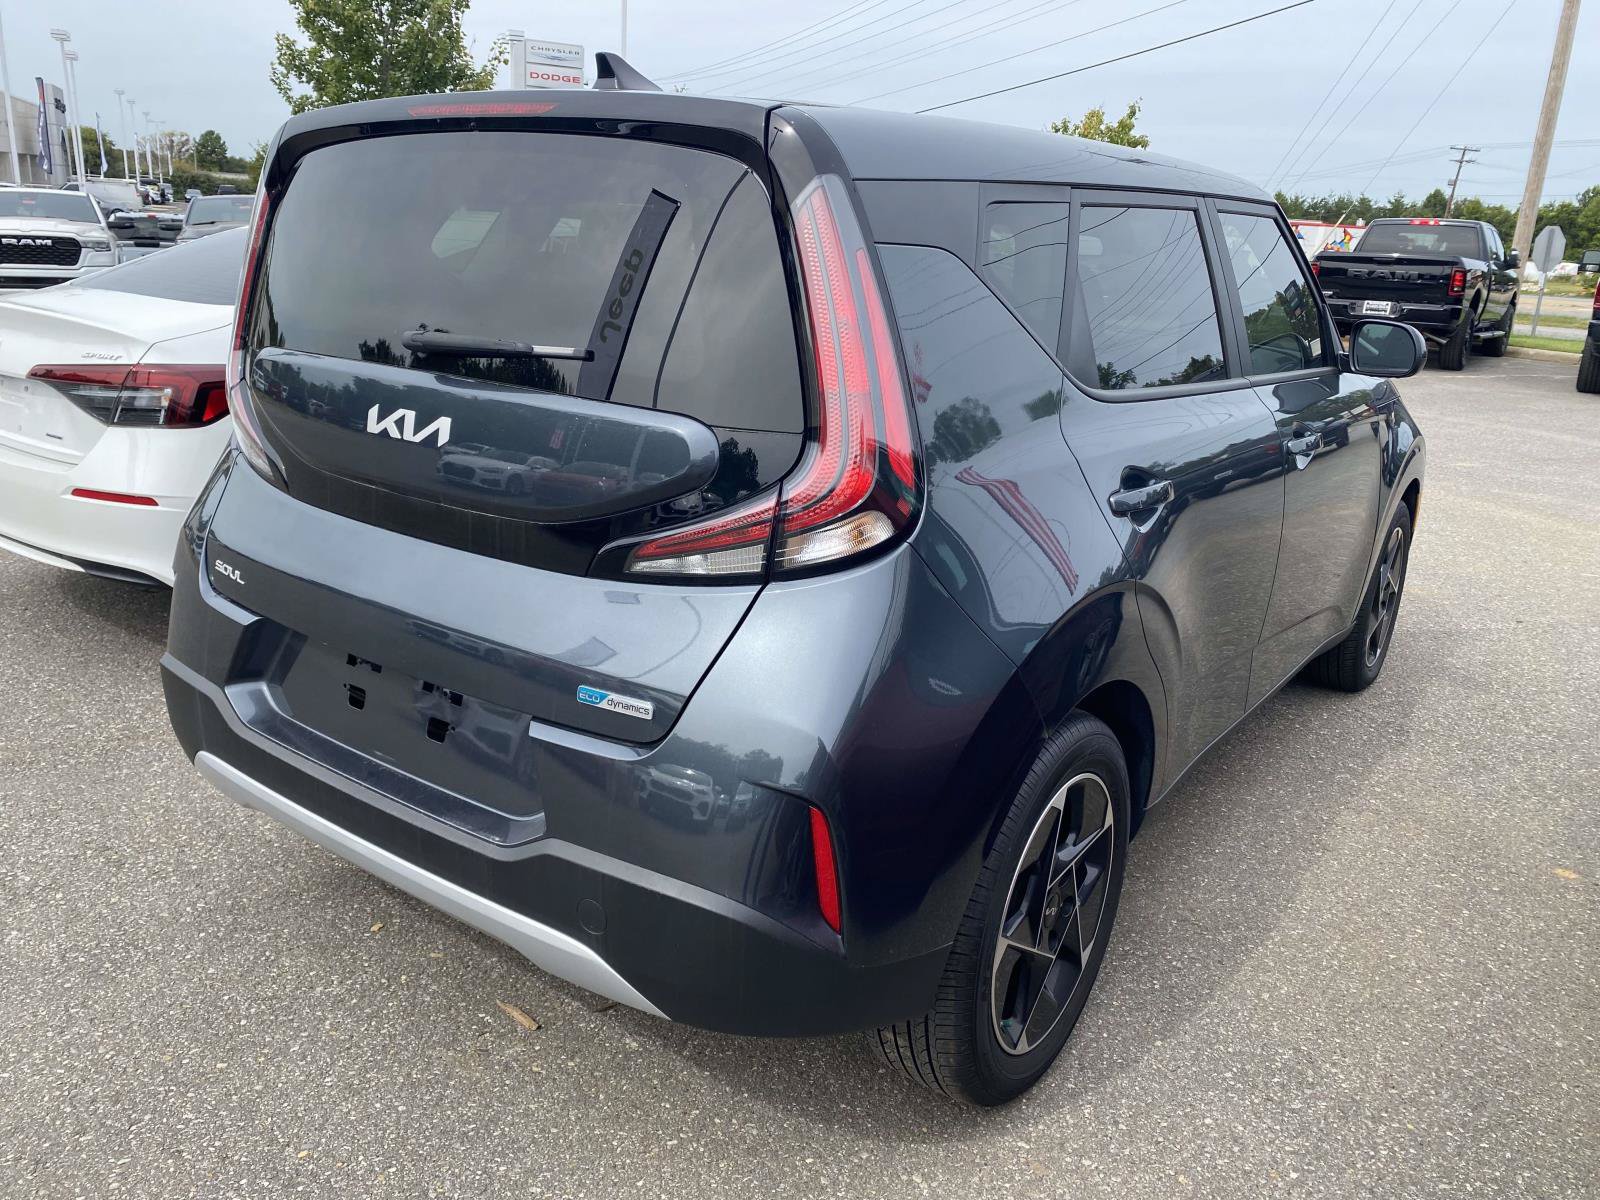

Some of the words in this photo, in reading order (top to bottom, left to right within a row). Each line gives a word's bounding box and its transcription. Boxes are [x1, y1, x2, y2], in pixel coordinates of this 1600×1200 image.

[530, 45, 581, 56] CHRYSLER
[529, 71, 581, 84] DODGE
[1, 238, 53, 246] RAM
[1346, 268, 1419, 281] RAM
[81, 352, 122, 361] SPORT
[366, 403, 452, 448] KIA
[214, 559, 245, 585] SOUL
[606, 697, 651, 716] dynamics
